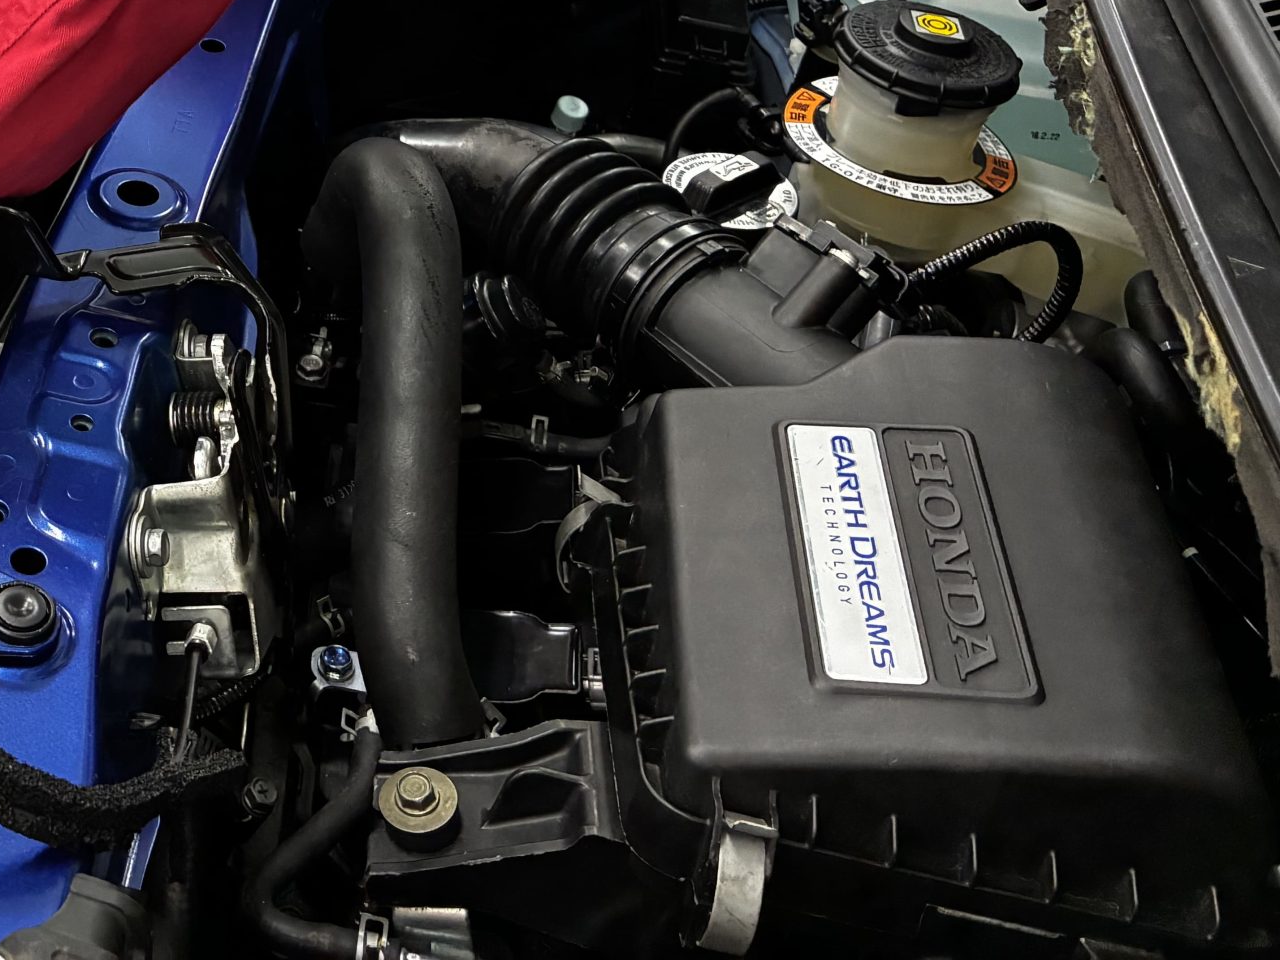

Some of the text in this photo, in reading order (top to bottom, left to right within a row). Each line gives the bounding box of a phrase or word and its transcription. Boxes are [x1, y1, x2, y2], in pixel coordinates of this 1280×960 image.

[782, 189, 793, 203] OIL
[820, 484, 852, 605] TECHNOLOGY
[830, 434, 895, 669] EARTH DREAMS
[905, 439, 998, 682] HONDA
